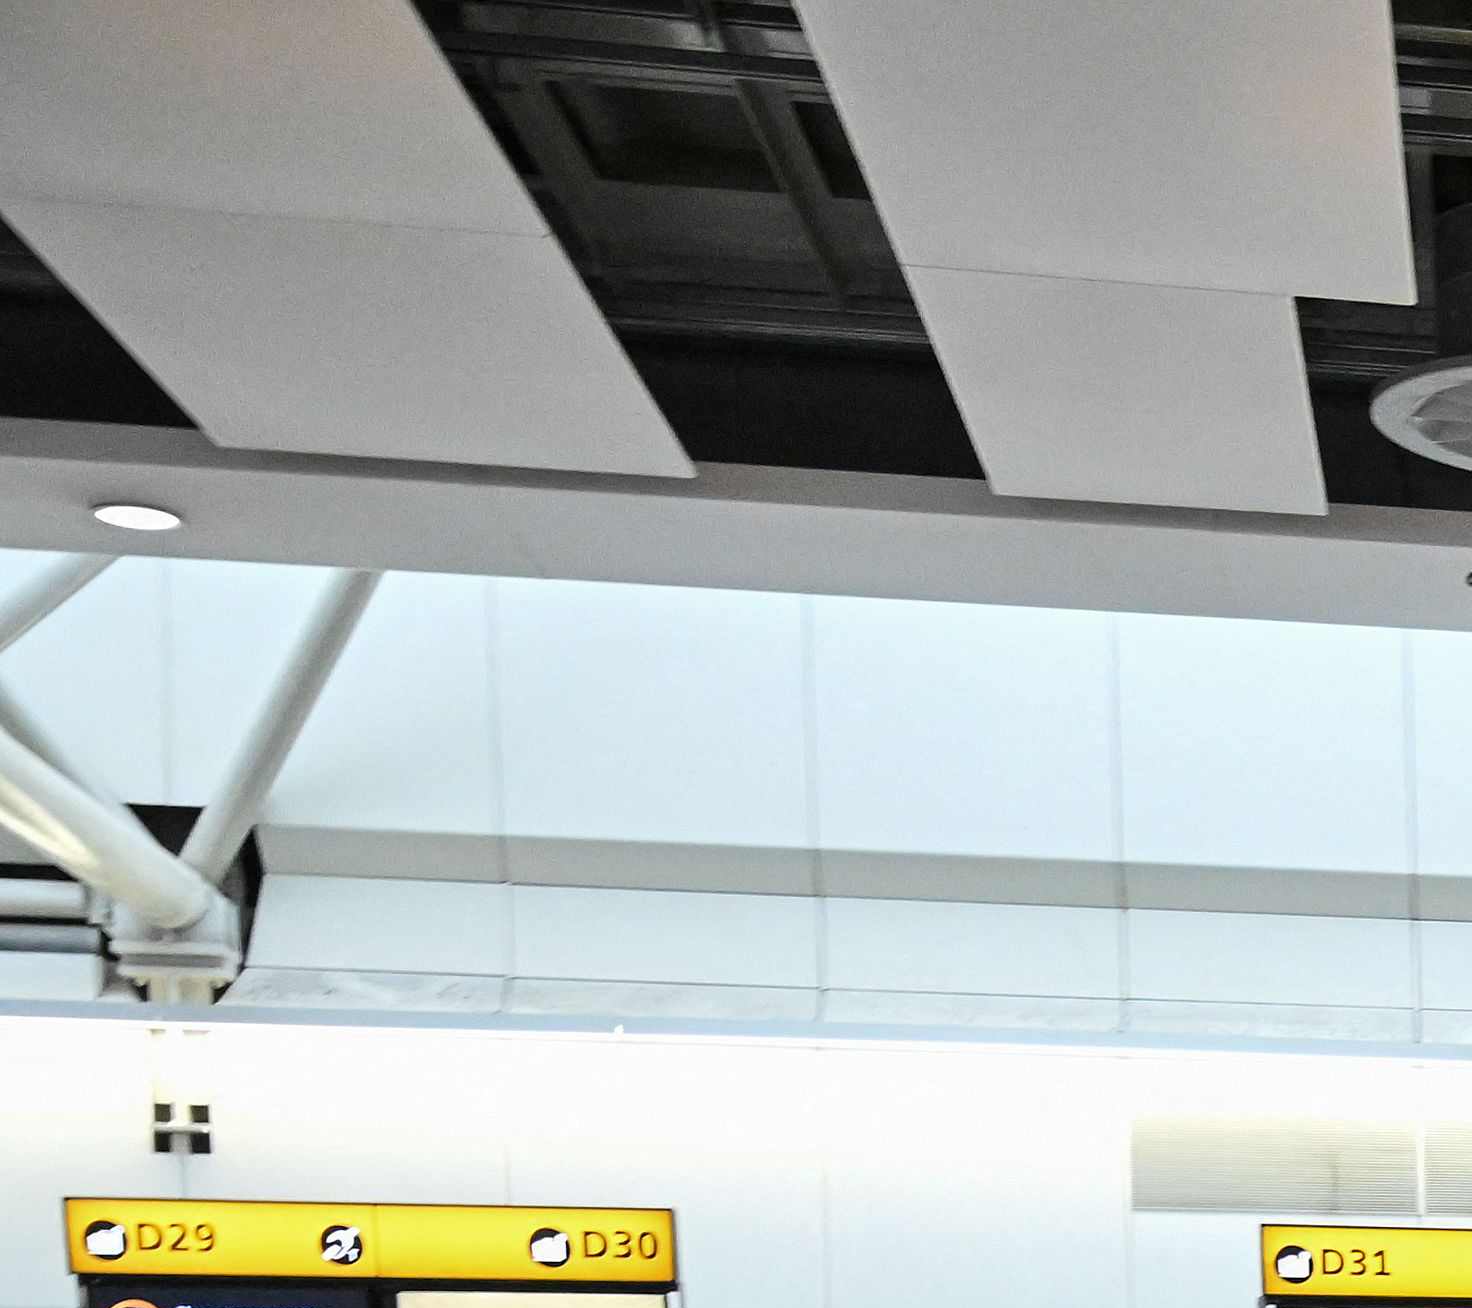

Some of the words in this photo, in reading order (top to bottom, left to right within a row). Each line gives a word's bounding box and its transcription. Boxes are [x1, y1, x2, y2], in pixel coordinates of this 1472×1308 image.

[137, 1223, 215, 1251] D29
[583, 1230, 658, 1260] D30
[1322, 1248, 1391, 1276] D31
